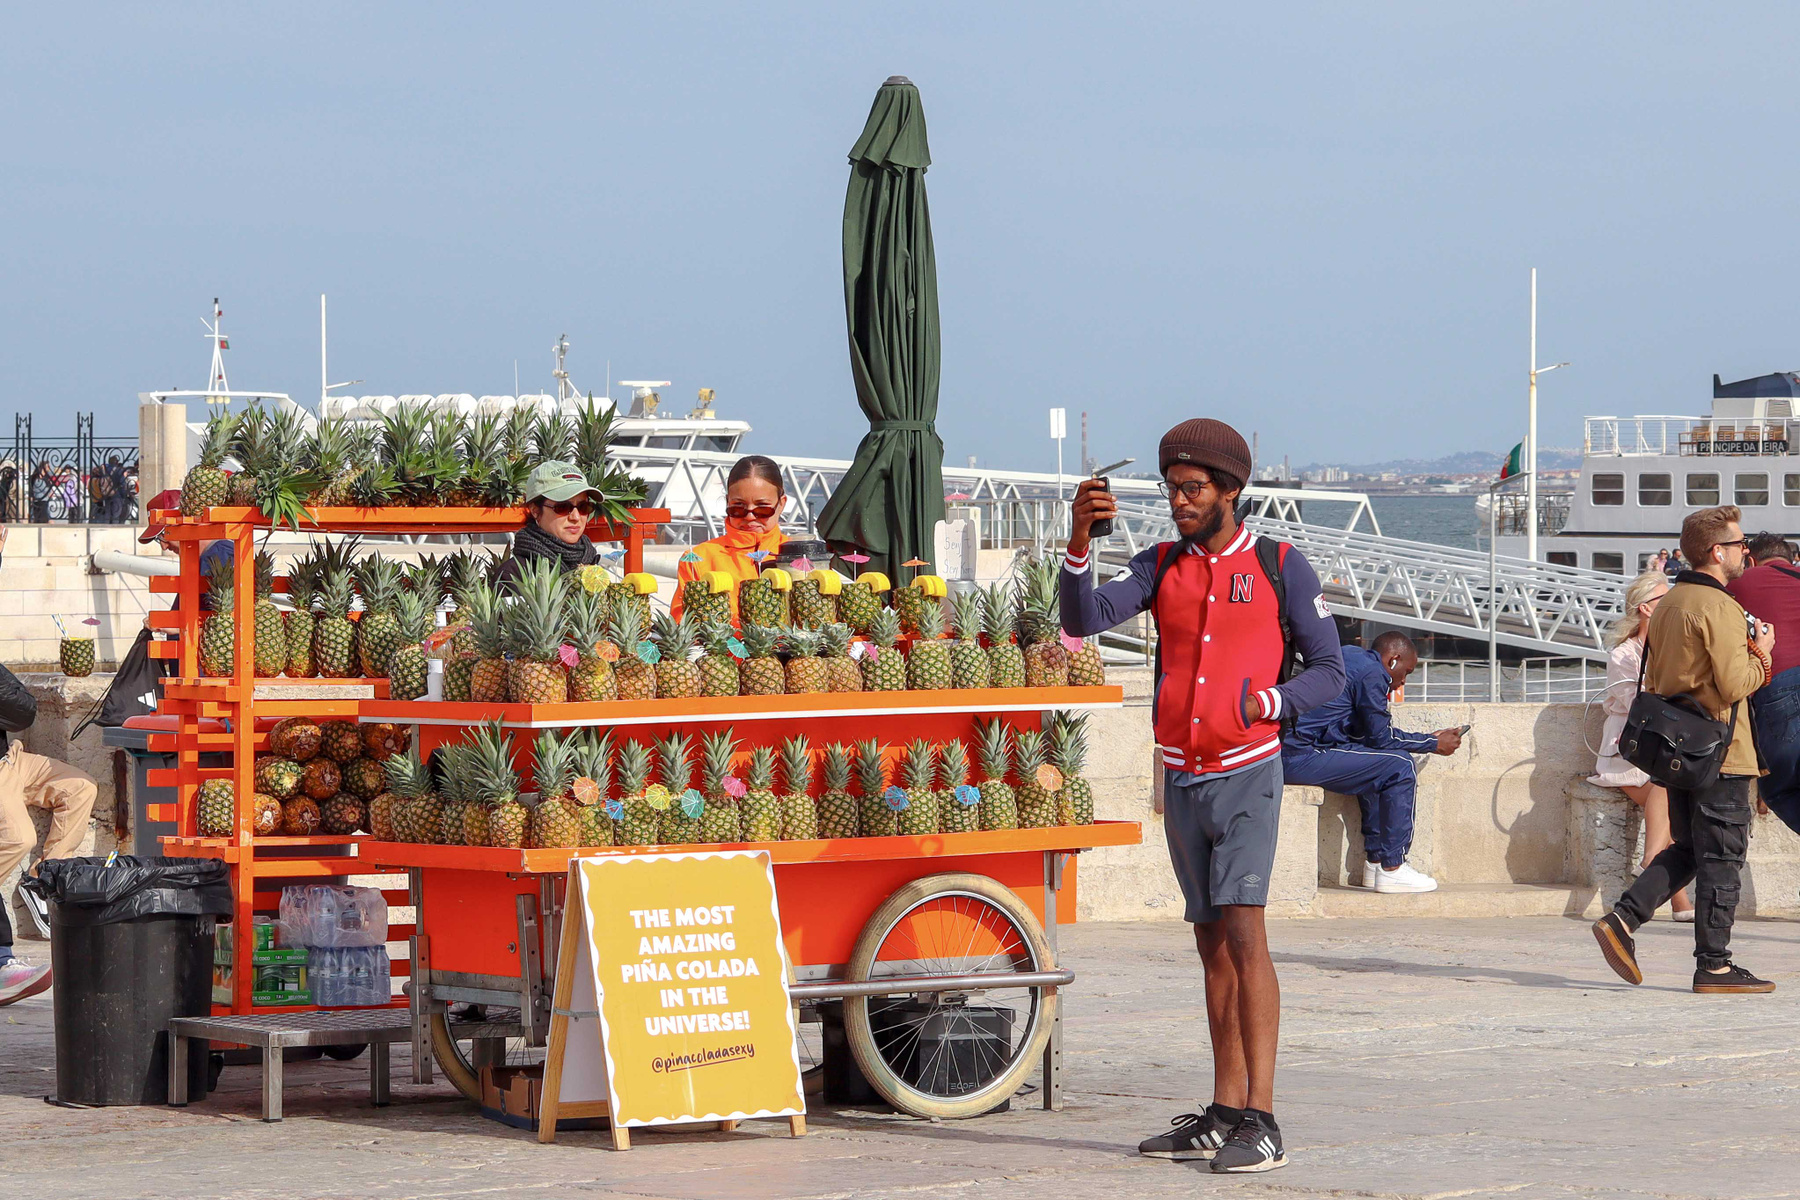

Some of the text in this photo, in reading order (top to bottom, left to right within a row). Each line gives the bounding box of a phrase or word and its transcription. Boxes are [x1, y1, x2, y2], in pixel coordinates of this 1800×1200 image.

[1700, 442, 1741, 452] PRNCIPE
[1743, 442, 1756, 451] DA
[1229, 573, 1254, 602] N
[629, 905, 736, 929] THE MOST
[638, 931, 736, 956] AMAZING
[621, 957, 761, 984] PIÑA COLADA
[660, 985, 729, 1009] IN THE
[644, 1009, 751, 1037] UNIVERSE!
[651, 1043, 755, 1073] @pinacoladasexy
